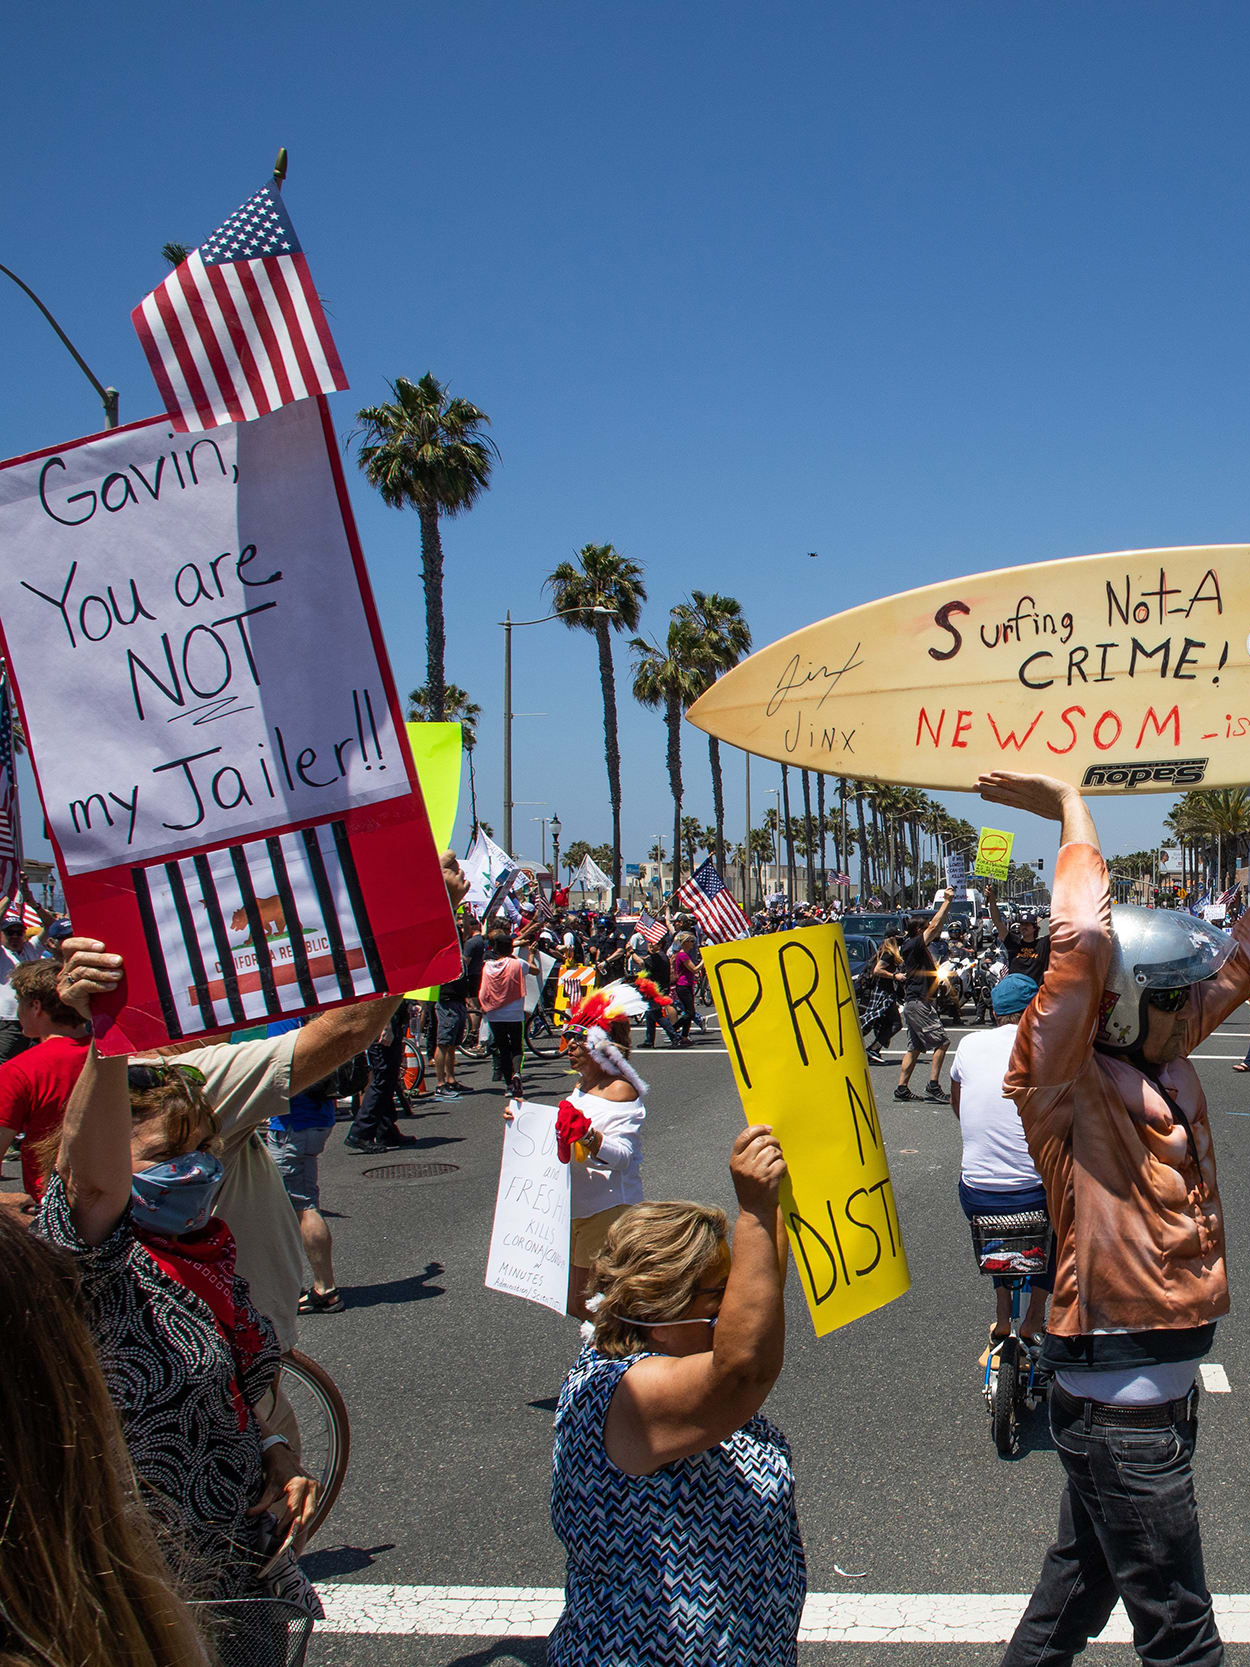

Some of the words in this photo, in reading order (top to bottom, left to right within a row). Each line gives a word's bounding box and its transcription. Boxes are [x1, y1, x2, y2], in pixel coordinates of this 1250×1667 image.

[39, 433, 239, 526] Gavin,
[20, 561, 157, 648] You
[175, 543, 283, 607] are
[928, 596, 1074, 661] Surfing
[127, 601, 277, 721] NOT
[1018, 637, 1229, 690] CRIME!
[916, 703, 1180, 755] NEWSOM
[69, 785, 139, 844] my
[153, 689, 387, 830] Jailer!!
[215, 949, 277, 974] CIFORA
[280, 937, 329, 958] REBLIC
[512, 1111, 557, 1158] SU
[543, 1165, 560, 1182] and
[505, 1176, 566, 1226] FRESH
[525, 1218, 556, 1245] KILLS
[789, 1177, 902, 1307] DIST
[499, 1261, 544, 1287] MINUTES
